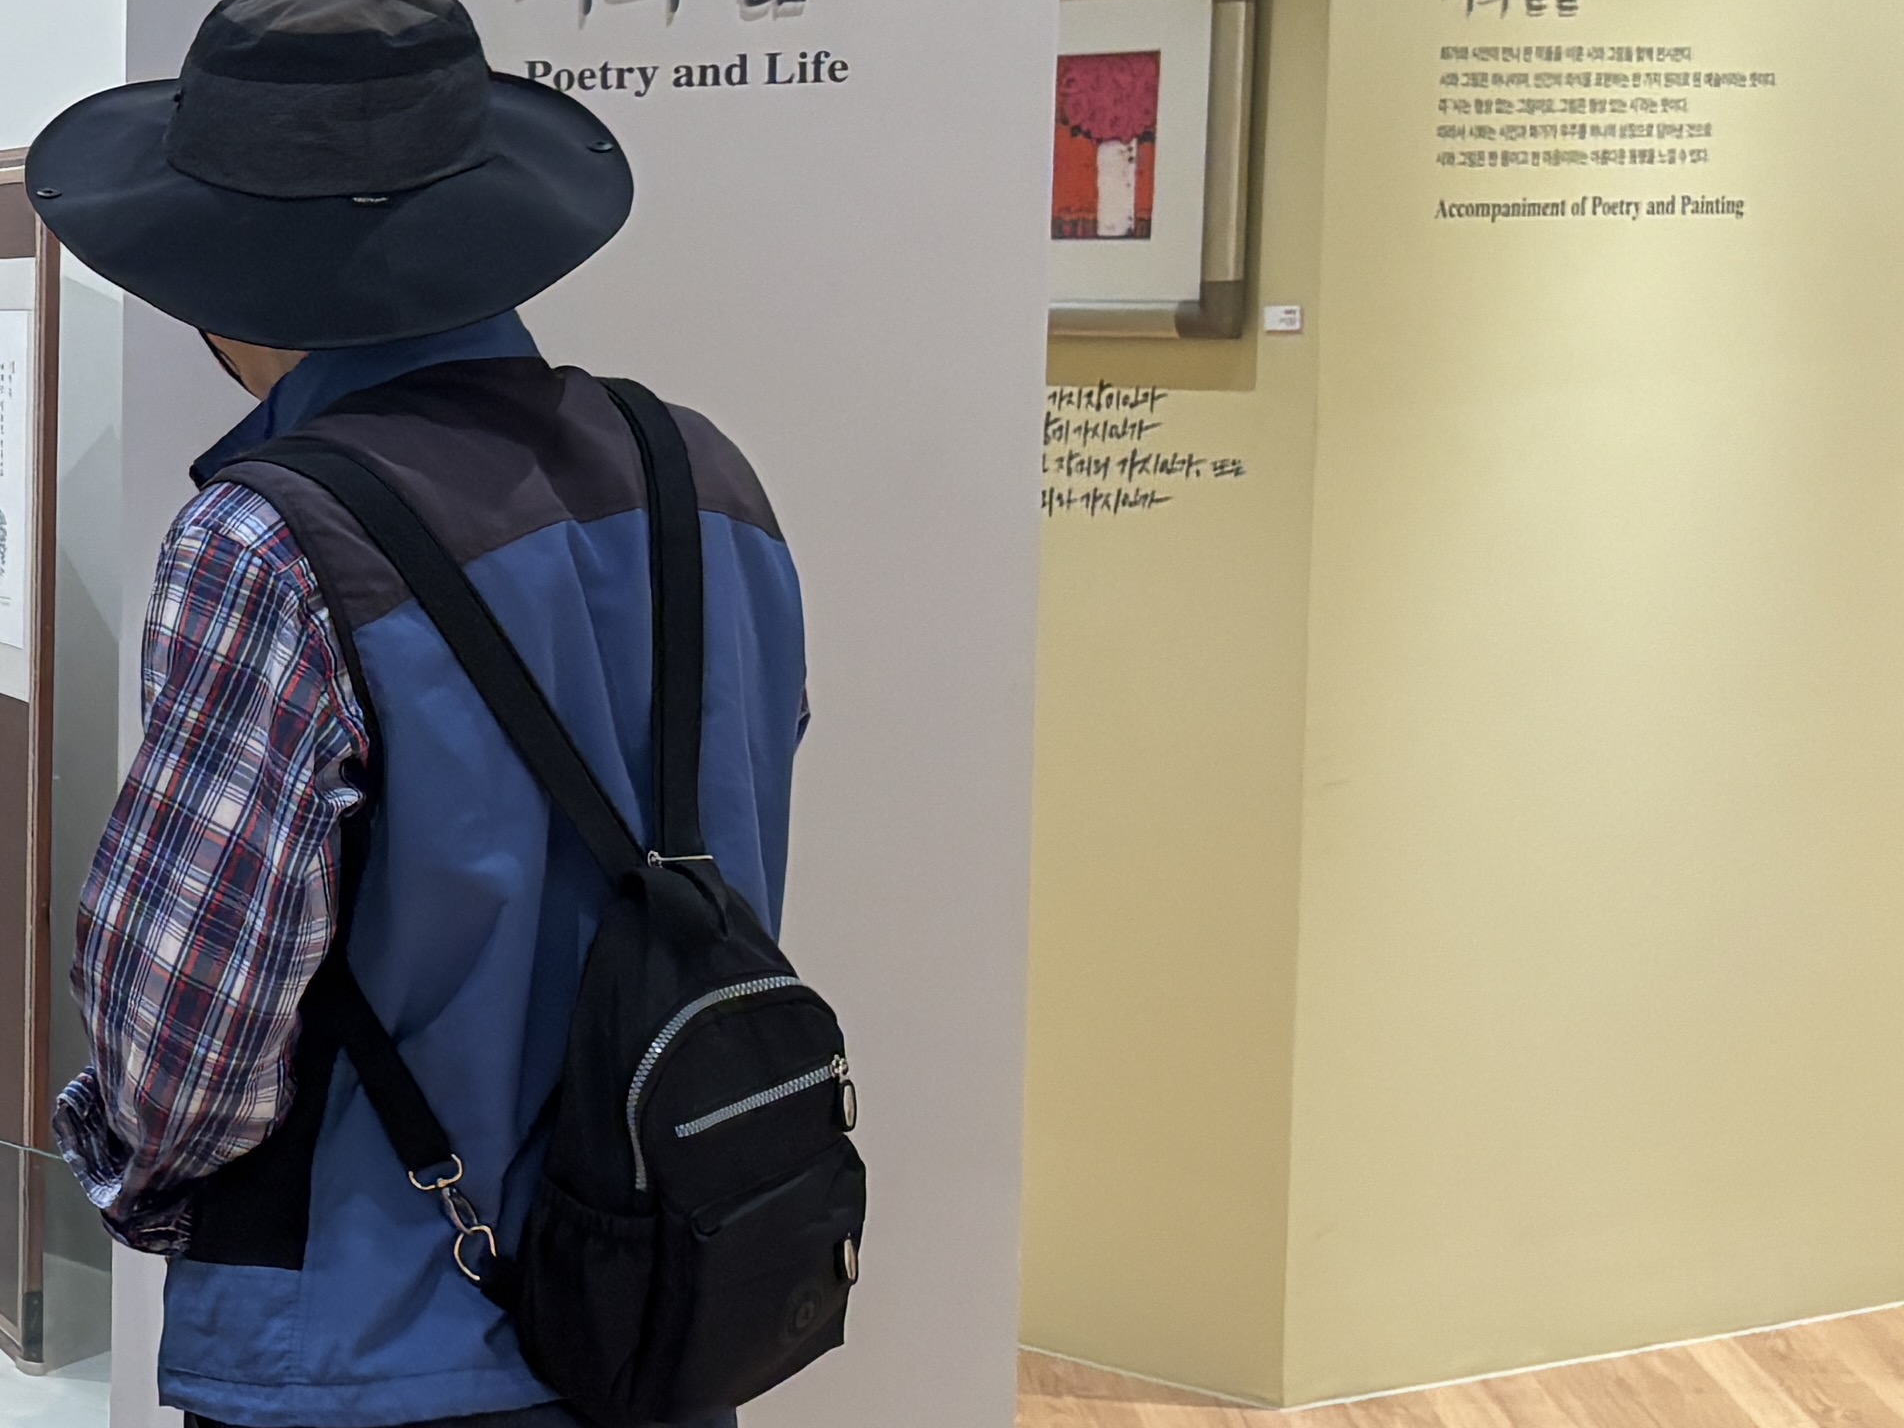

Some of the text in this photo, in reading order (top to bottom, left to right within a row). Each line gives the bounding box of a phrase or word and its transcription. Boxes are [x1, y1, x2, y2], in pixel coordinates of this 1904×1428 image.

[525, 50, 850, 98] Poetry and Life
[1435, 194, 1745, 222] Accompaniment of Poetry and Painting
